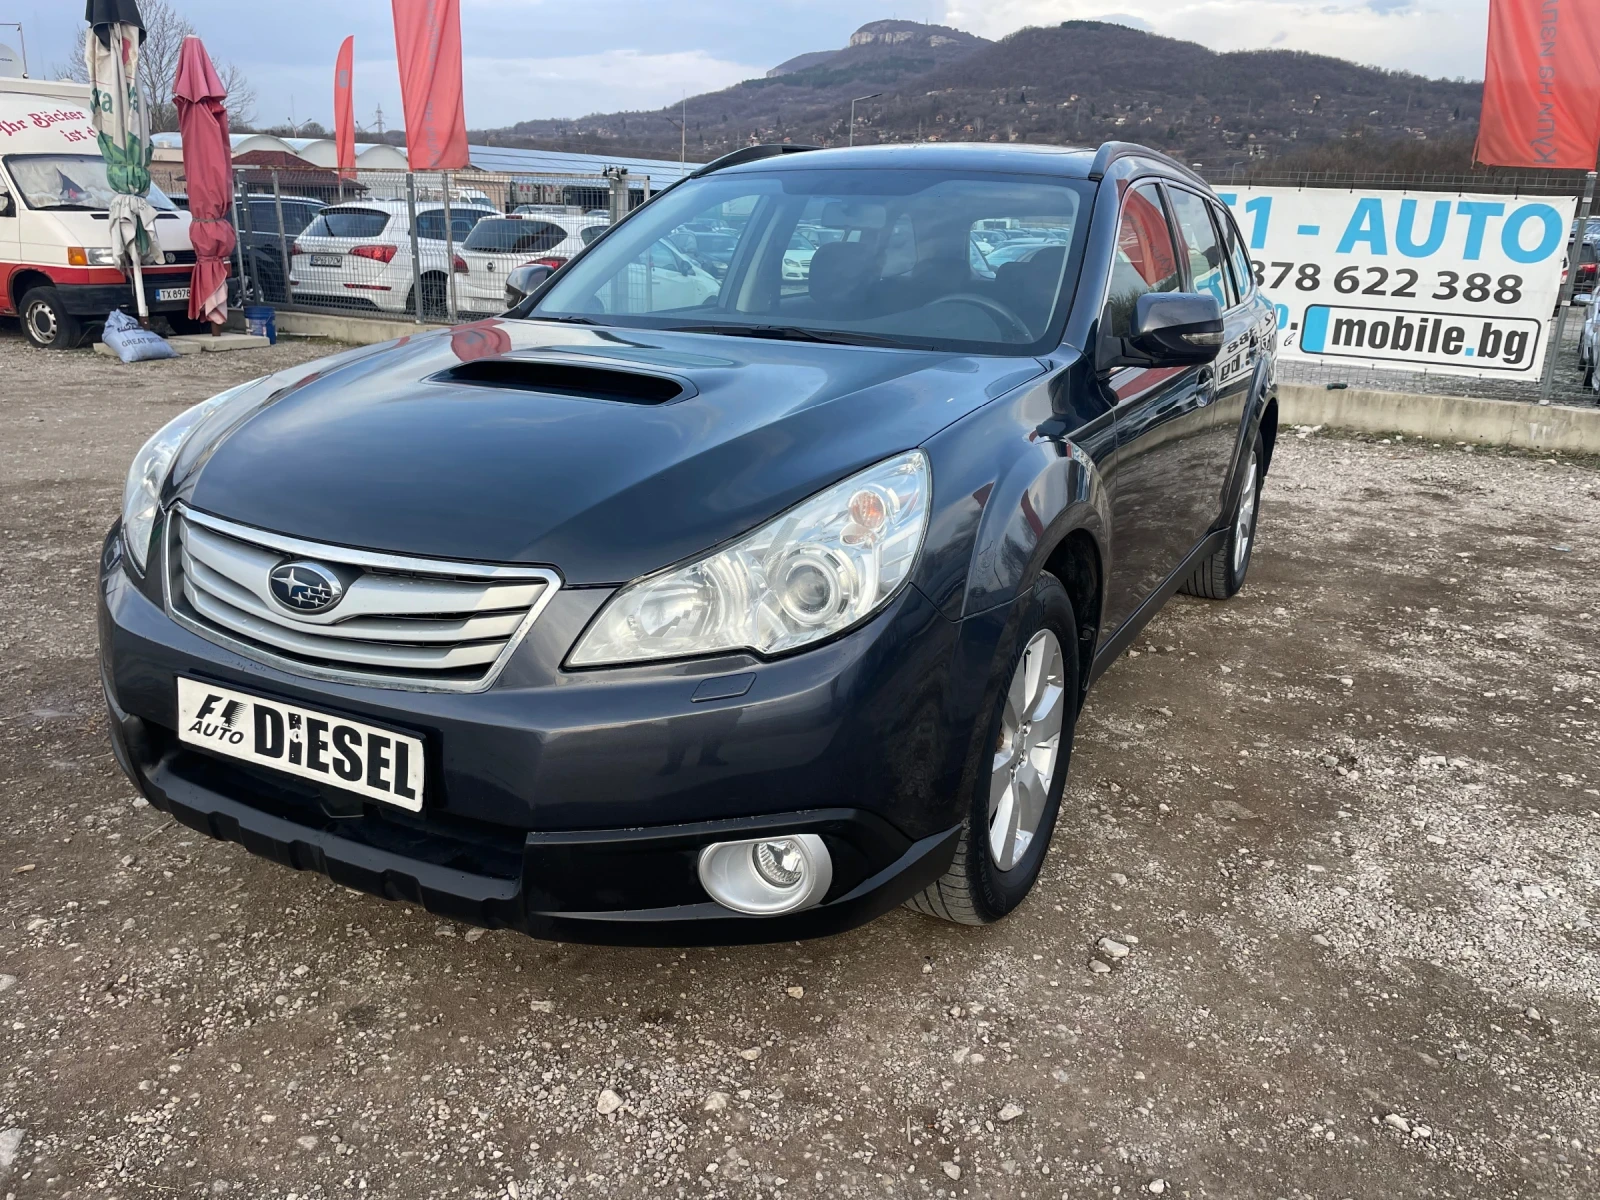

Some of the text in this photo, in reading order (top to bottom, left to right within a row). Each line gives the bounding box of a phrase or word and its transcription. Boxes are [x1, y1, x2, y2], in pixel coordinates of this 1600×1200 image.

[28, 109, 87, 128] Bäcker
[60, 129, 87, 142] ist
[1217, 193, 1272, 249] 1
[1335, 197, 1563, 264] AUTO
[1333, 265, 1419, 298] 622
[1431, 270, 1524, 304] 388
[1331, 316, 1529, 364] mobile.bg
[188, 720, 245, 744] AUTO
[253, 703, 416, 800] DIESEL
